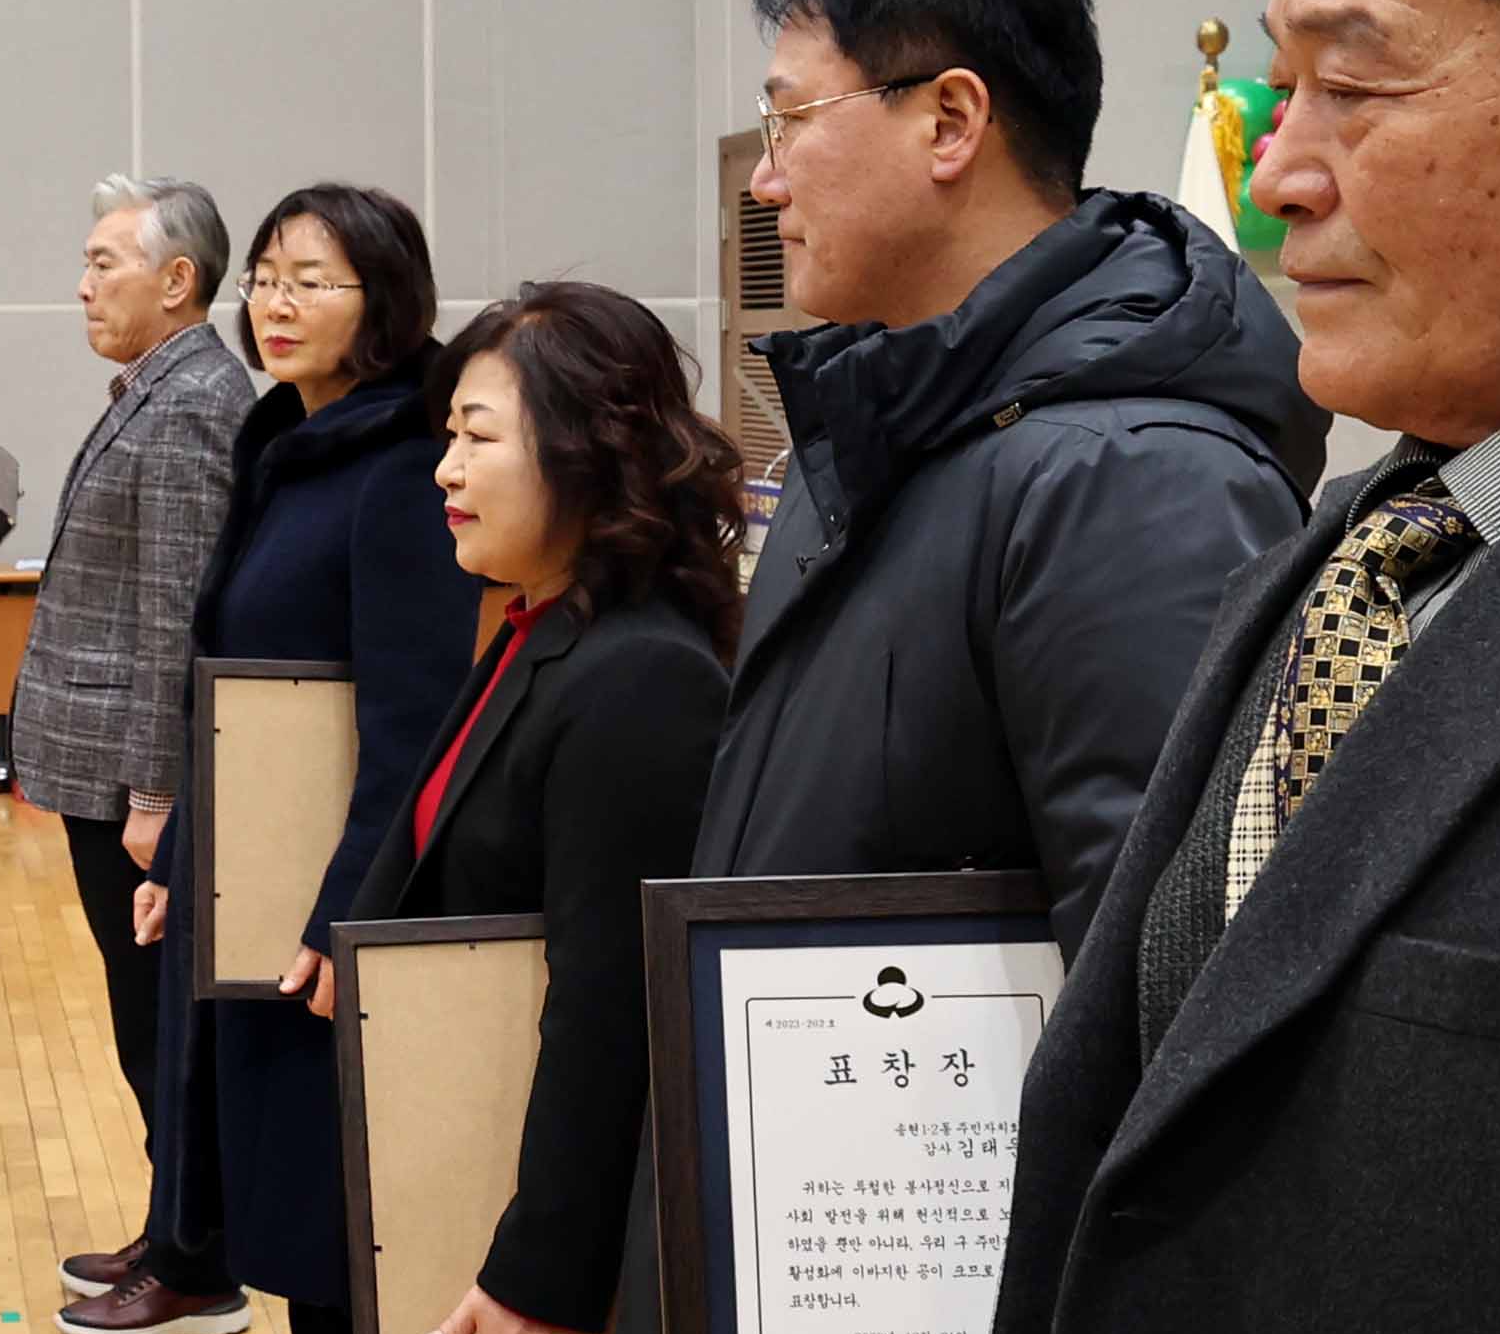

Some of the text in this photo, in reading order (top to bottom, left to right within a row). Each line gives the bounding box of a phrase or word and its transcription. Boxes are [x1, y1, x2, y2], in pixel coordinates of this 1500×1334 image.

[801, 1180, 845, 1195] 귀하는
[904, 1178, 990, 1195] 봉사정신으로
[785, 1208, 812, 1223] 사회
[824, 1208, 867, 1225] 발전을
[877, 1208, 905, 1223] 위해
[916, 1207, 989, 1224] 헌신적으로
[787, 1236, 827, 1253] 하였을
[835, 1236, 862, 1253] 뿐만
[919, 1235, 945, 1251] 우리
[953, 1235, 967, 1250] 구
[789, 1263, 995, 1281] 활성화에 이바지한 공이 크므로
[789, 1292, 861, 1309] 표창합니다.
